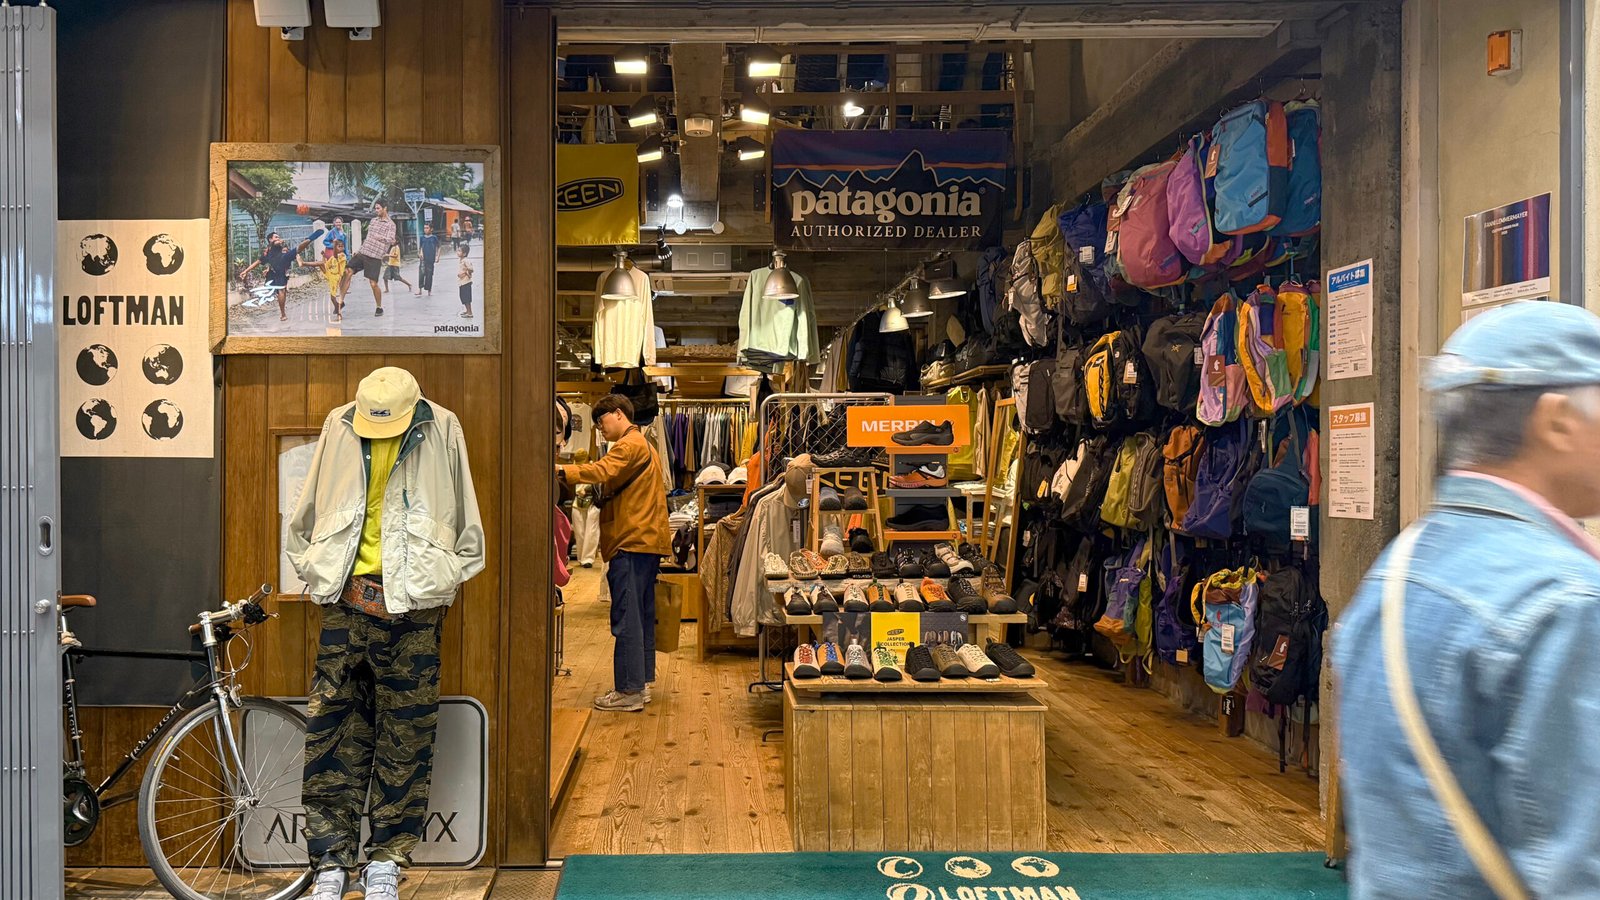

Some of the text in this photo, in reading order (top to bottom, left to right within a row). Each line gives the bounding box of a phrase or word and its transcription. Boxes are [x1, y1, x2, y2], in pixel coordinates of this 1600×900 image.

[791, 186, 981, 223] patagonia
[791, 225, 982, 238] AUTHORIZED DEALER
[63, 295, 184, 325] LOFTMAN
[434, 324, 479, 334] patagonia
[862, 420, 935, 432] MERR
[133, 706, 177, 754] RALEIGH
[939, 886, 1081, 900] LOFTMAN
